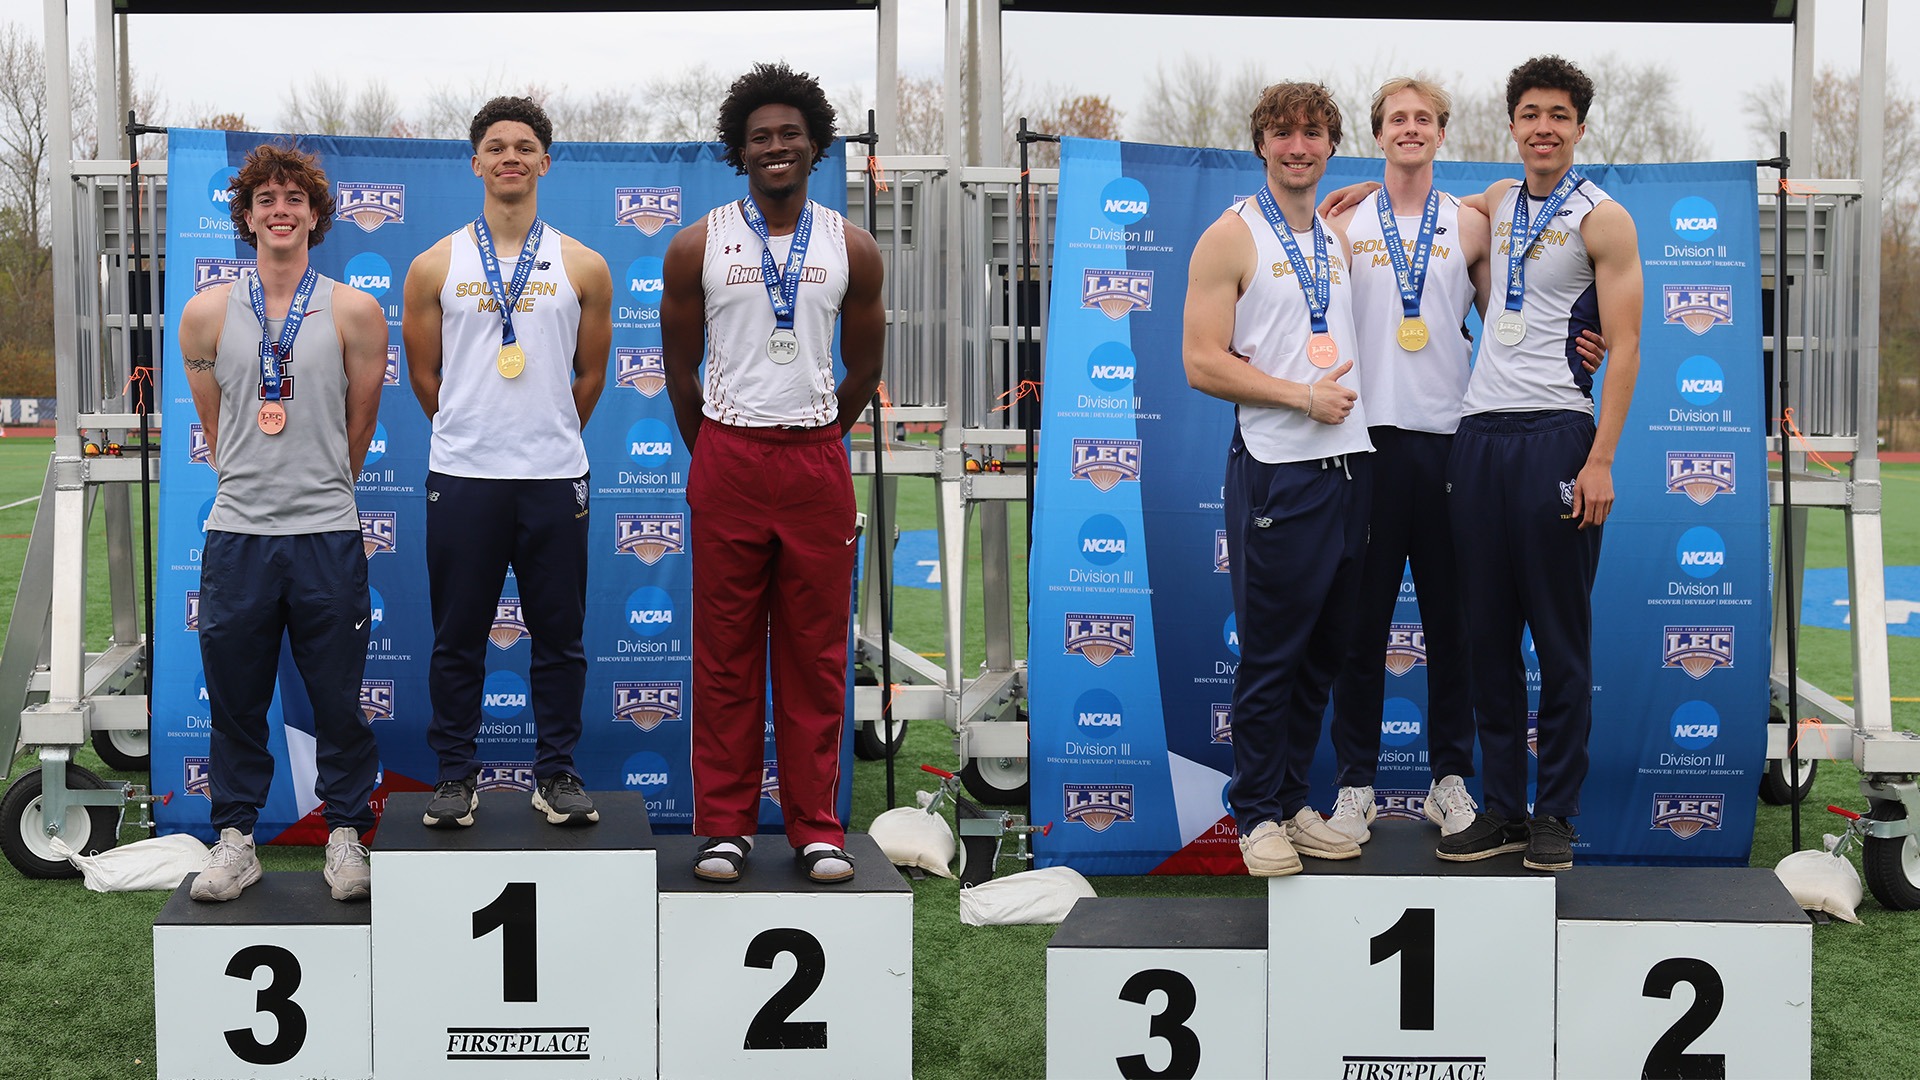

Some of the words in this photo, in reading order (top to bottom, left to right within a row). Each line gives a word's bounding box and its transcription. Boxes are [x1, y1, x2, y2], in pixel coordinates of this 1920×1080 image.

[340, 190, 400, 211] LEC
[619, 194, 678, 214] LEC
[1104, 199, 1147, 214] NCAA
[1675, 218, 1717, 230] NCAA
[1089, 227, 1140, 242] Division
[1145, 230, 1154, 242] III
[1664, 245, 1714, 257] Division
[1718, 246, 1727, 257] III
[349, 275, 390, 289] NCAA
[631, 279, 664, 292] NCA
[1086, 276, 1148, 299] LEC
[1667, 292, 1728, 313] LEC
[389, 304, 398, 317] III
[619, 306, 660, 319] Divisio
[620, 355, 664, 376] LE
[1091, 365, 1135, 379] NCAA
[1681, 379, 1723, 393] NCAA
[1077, 395, 1128, 409] Division
[1132, 396, 1142, 409] III
[1669, 408, 1719, 422] Division
[1723, 409, 1732, 423] III
[631, 442, 672, 455] NCAA
[1075, 446, 1137, 470] LEC
[385, 470, 394, 482] III
[618, 472, 668, 484] Division
[671, 472, 680, 484] III
[1670, 460, 1731, 482] LEC
[360, 520, 392, 539] EC
[619, 521, 680, 542] LEC
[1082, 538, 1126, 553] NCAA
[1681, 551, 1724, 565] NCAA
[1069, 568, 1120, 583] Division
[1124, 571, 1134, 584] III
[1668, 582, 1719, 595] Division
[1723, 582, 1732, 595] III
[630, 610, 672, 623] NCAA
[1068, 621, 1131, 645] LEC
[382, 638, 391, 650] III
[617, 639, 667, 652] Division
[671, 639, 680, 651] III
[1667, 634, 1730, 656] LEC
[484, 694, 526, 707] NCAA
[617, 689, 679, 710] LEC
[1078, 712, 1121, 726] NCAA
[478, 722, 521, 735] ivision
[525, 722, 535, 735] III
[1674, 724, 1718, 738] NCAA
[1065, 742, 1117, 755] Division
[1121, 743, 1131, 756] III
[1378, 750, 1415, 762] vision
[1419, 751, 1429, 762] III
[1660, 753, 1711, 766] Division
[1715, 754, 1725, 766] III
[626, 773, 668, 785] NCAA
[665, 799, 675, 810] III
[1067, 791, 1130, 812] LEC
[1656, 800, 1719, 819] LEC
[471, 882, 538, 1003] 1
[1369, 908, 1435, 1031] 1
[743, 928, 828, 1050] 2
[223, 944, 307, 1065] 3
[1116, 968, 1201, 1080] 3
[1641, 957, 1726, 1080] 2
[446, 1034, 513, 1052] FIRST
[517, 1034, 590, 1052] PLACE
